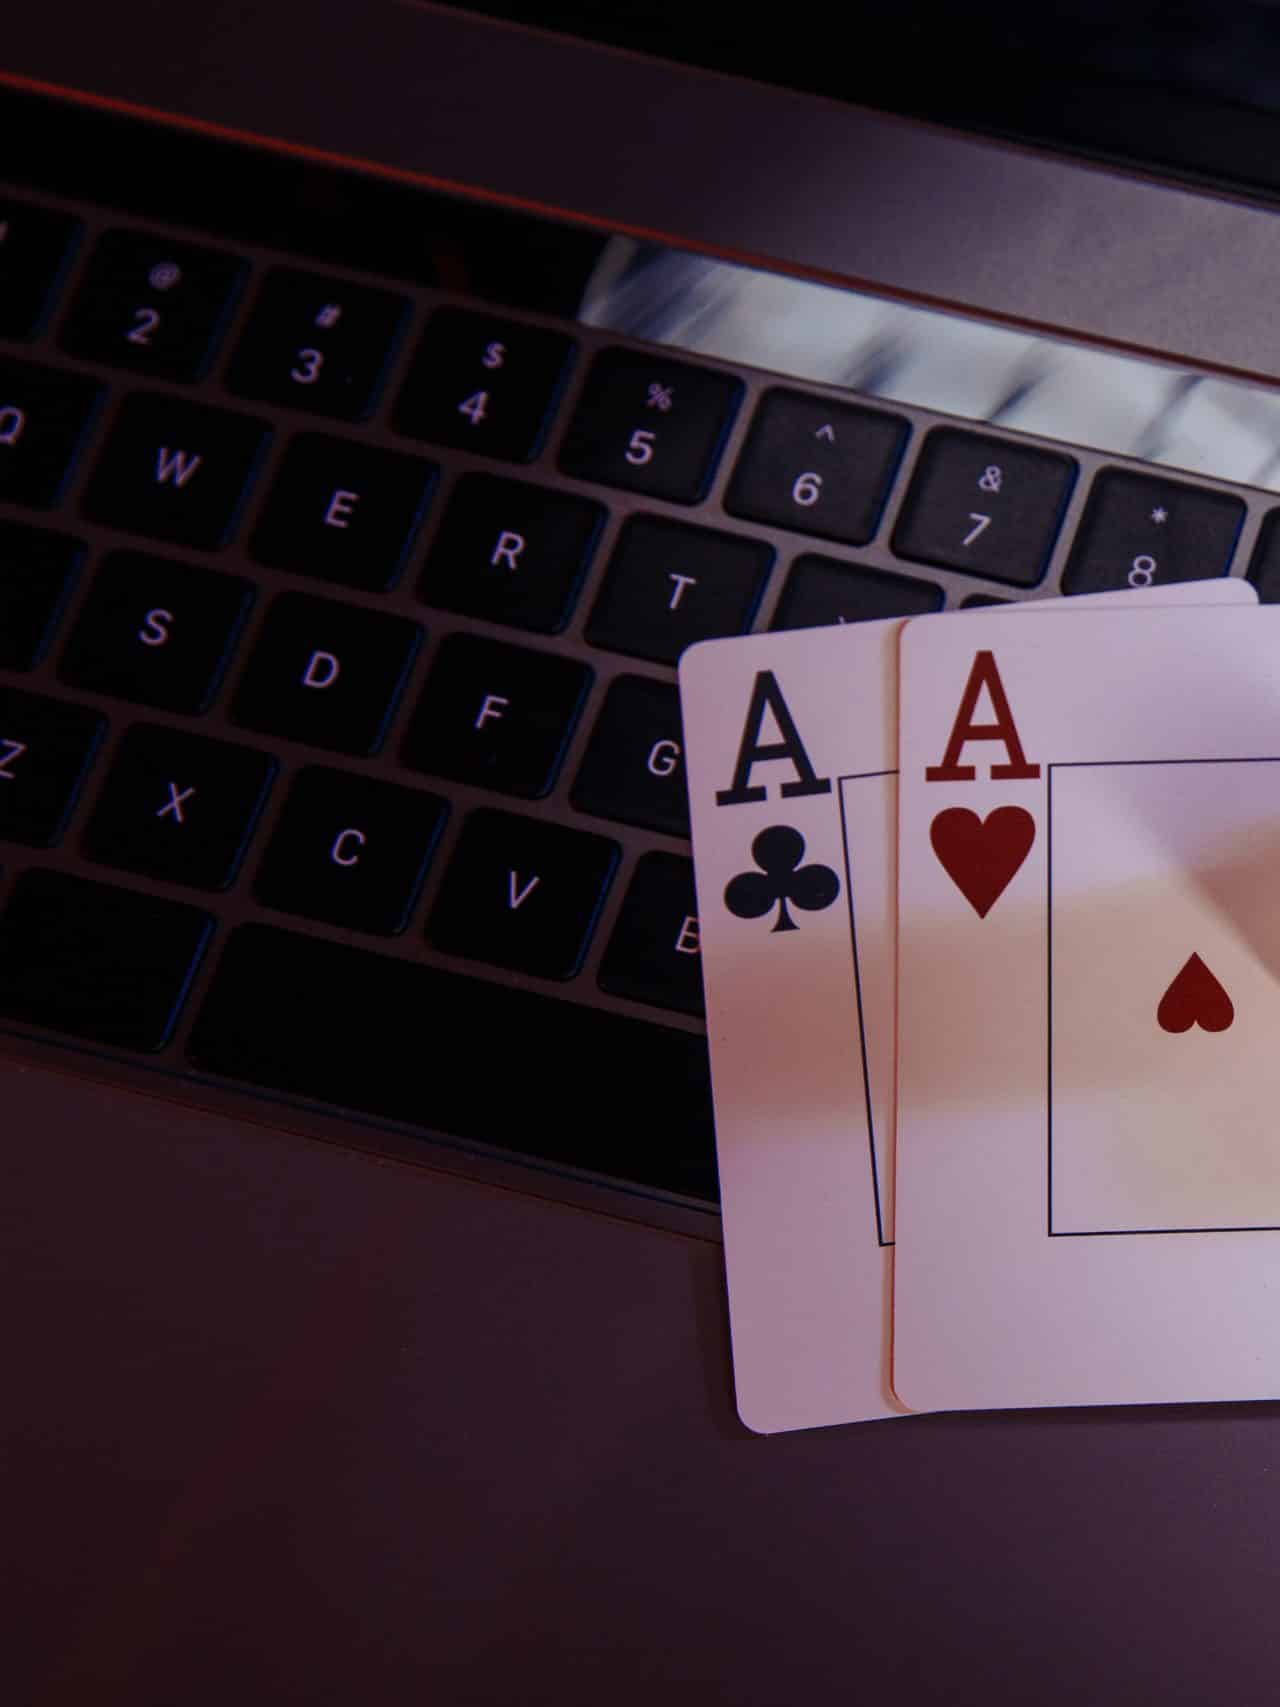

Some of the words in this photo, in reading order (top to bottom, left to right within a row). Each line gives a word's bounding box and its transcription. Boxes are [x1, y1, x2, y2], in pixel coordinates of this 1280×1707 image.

[126, 308, 160, 345] 2
[291, 348, 323, 383] 3
[458, 391, 488, 423] 4
[647, 383, 672, 411] %
[624, 429, 655, 465] 5
[155, 447, 200, 486] W
[978, 465, 1002, 492] &
[791, 472, 822, 506] 6
[323, 489, 359, 528] E
[962, 512, 991, 546] 7
[490, 531, 525, 569] R
[1128, 556, 1156, 586] 8
[669, 573, 696, 609] T
[137, 607, 173, 646] S
[301, 651, 340, 688] D
[474, 694, 509, 729] F
[926, 651, 1040, 782] A
[716, 670, 831, 806] A
[0, 738, 27, 779] Z
[648, 739, 679, 776] G
[156, 782, 195, 823] X
[330, 828, 366, 866] C
[508, 870, 540, 909] V
